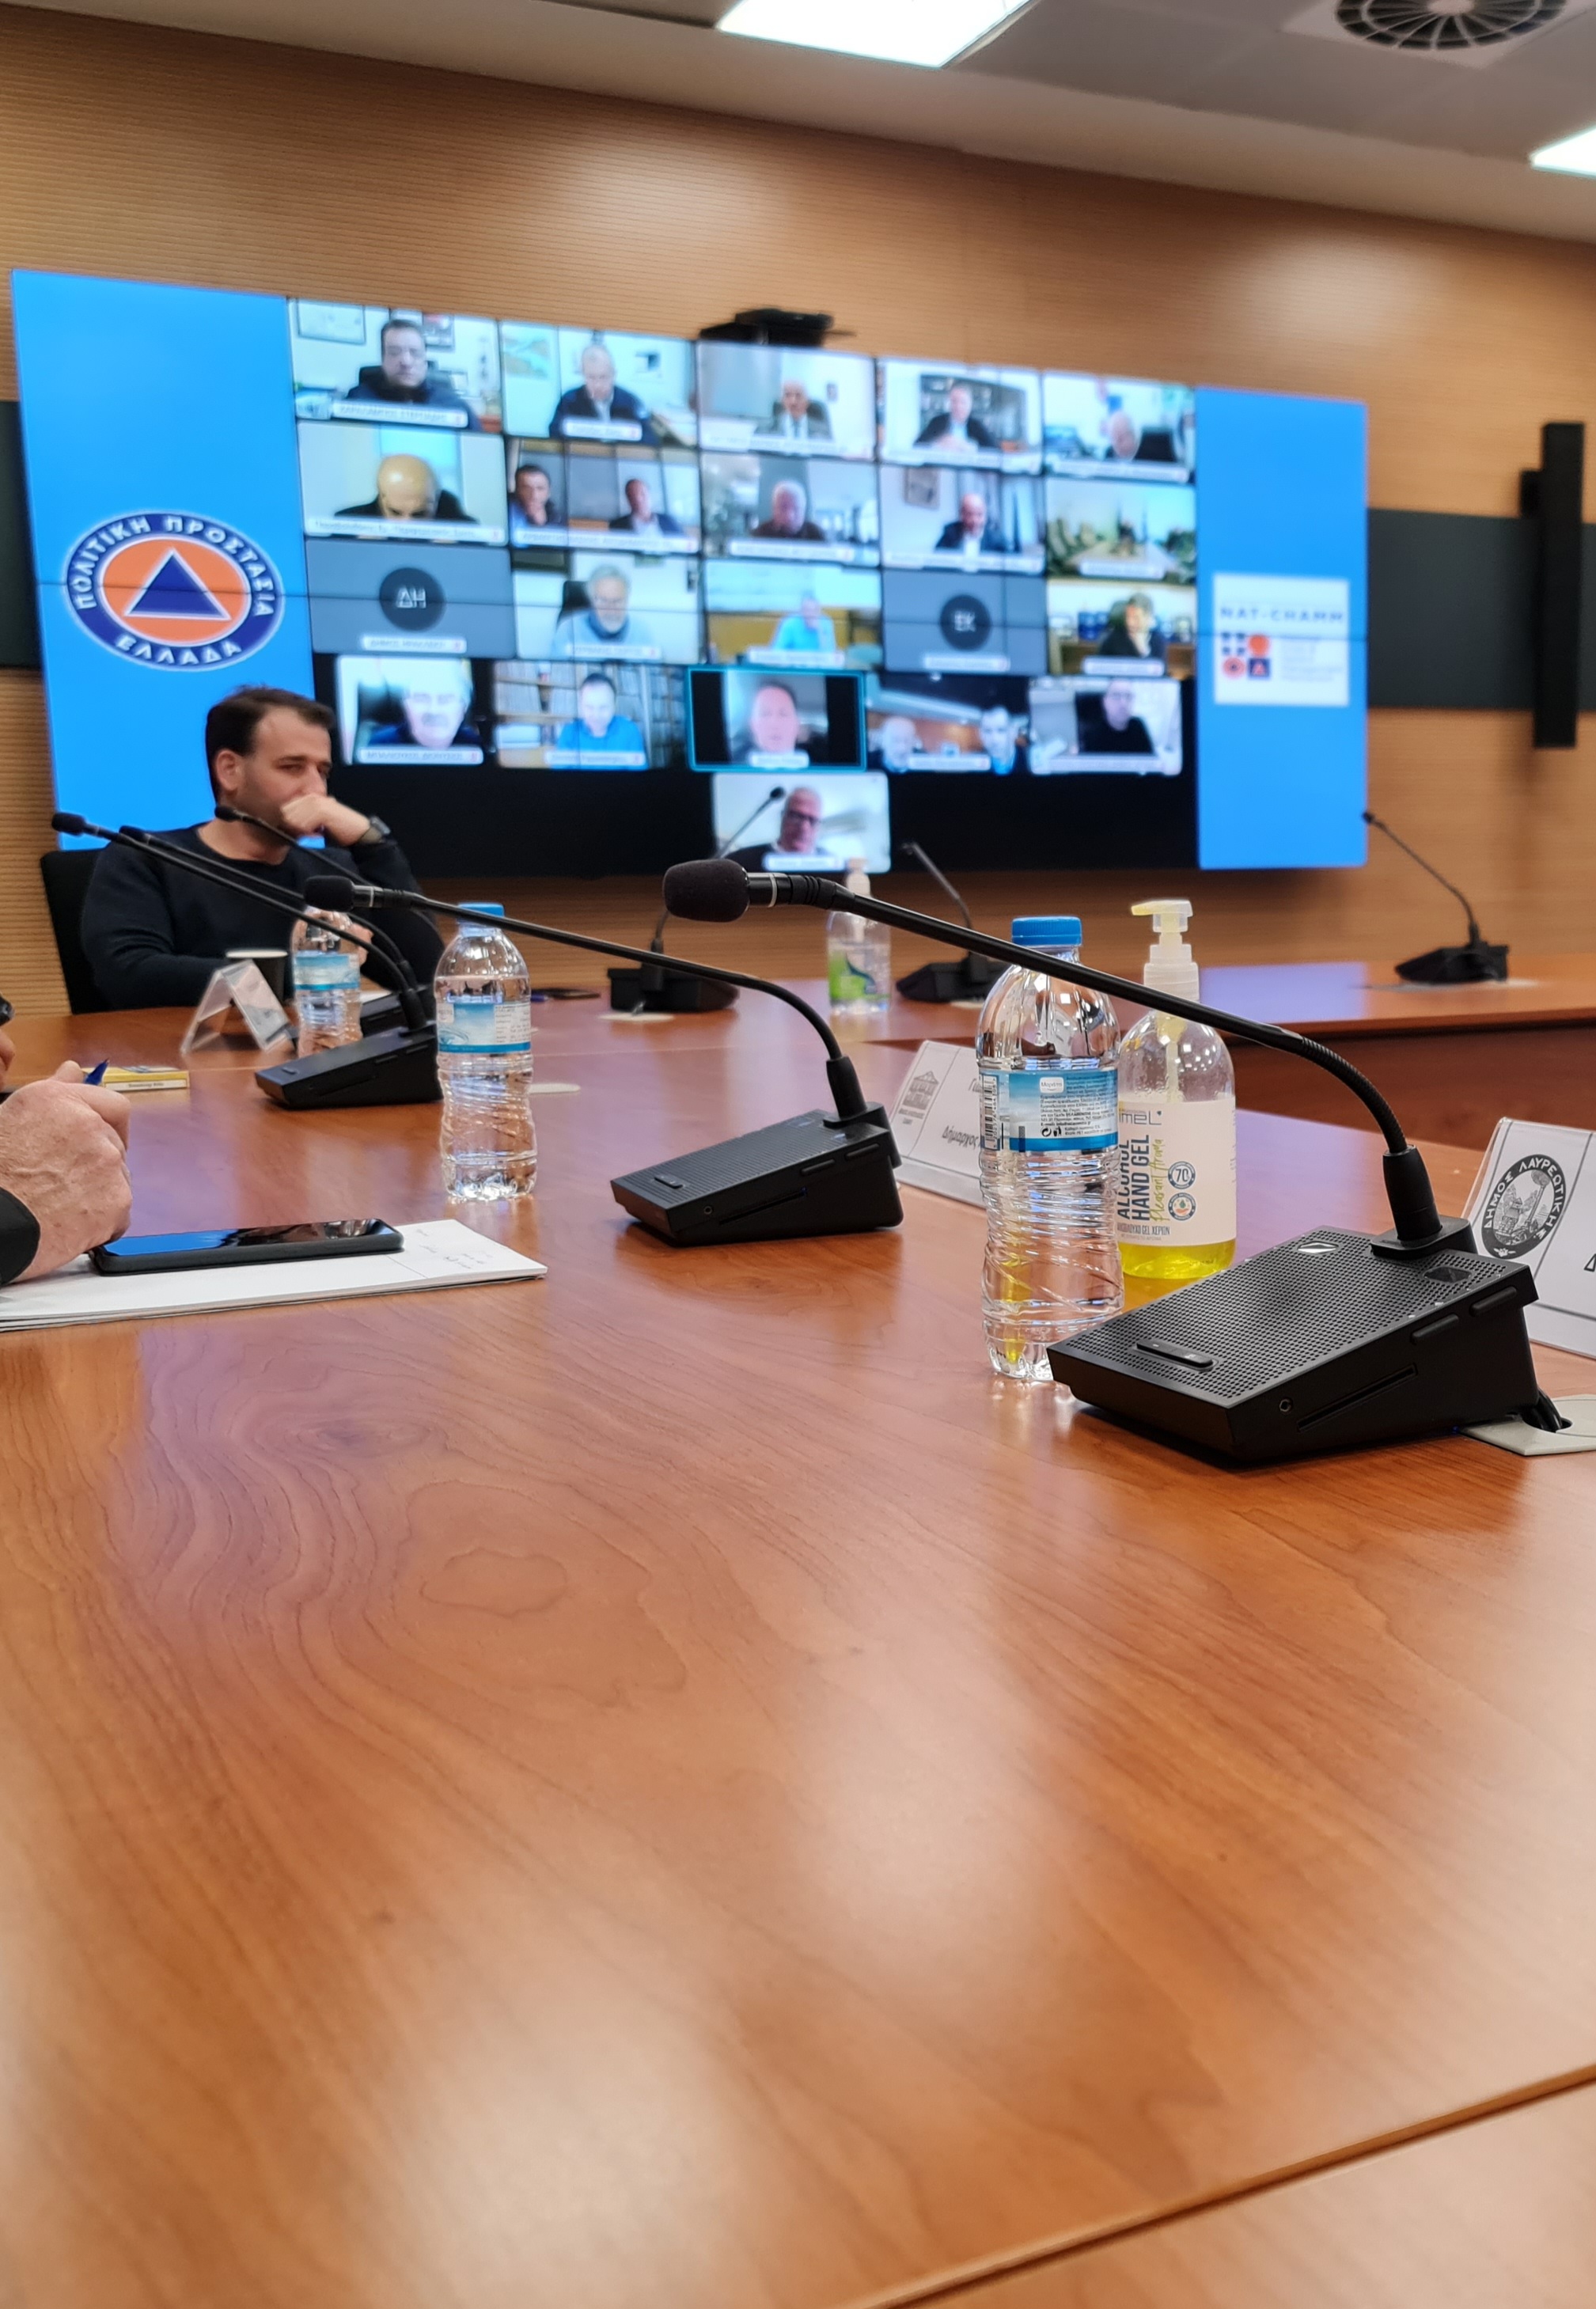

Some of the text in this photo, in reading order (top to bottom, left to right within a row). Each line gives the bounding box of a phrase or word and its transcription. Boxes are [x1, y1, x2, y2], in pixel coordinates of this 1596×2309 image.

[70, 515, 275, 616] ΠΟΛΙΤΙΚΗ ΠΡΟΣΤΑΣΙΑ
[396, 587, 426, 609] ΔΗ
[116, 634, 241, 665] ΕΛΛΑΔΑ
[1131, 1135, 1150, 1166] GEL
[1131, 1172, 1150, 1221] HAND
[1148, 1139, 1170, 1222] Pleasant Aroma
[1484, 1171, 1513, 1228] ΔΗΜΟΣ
